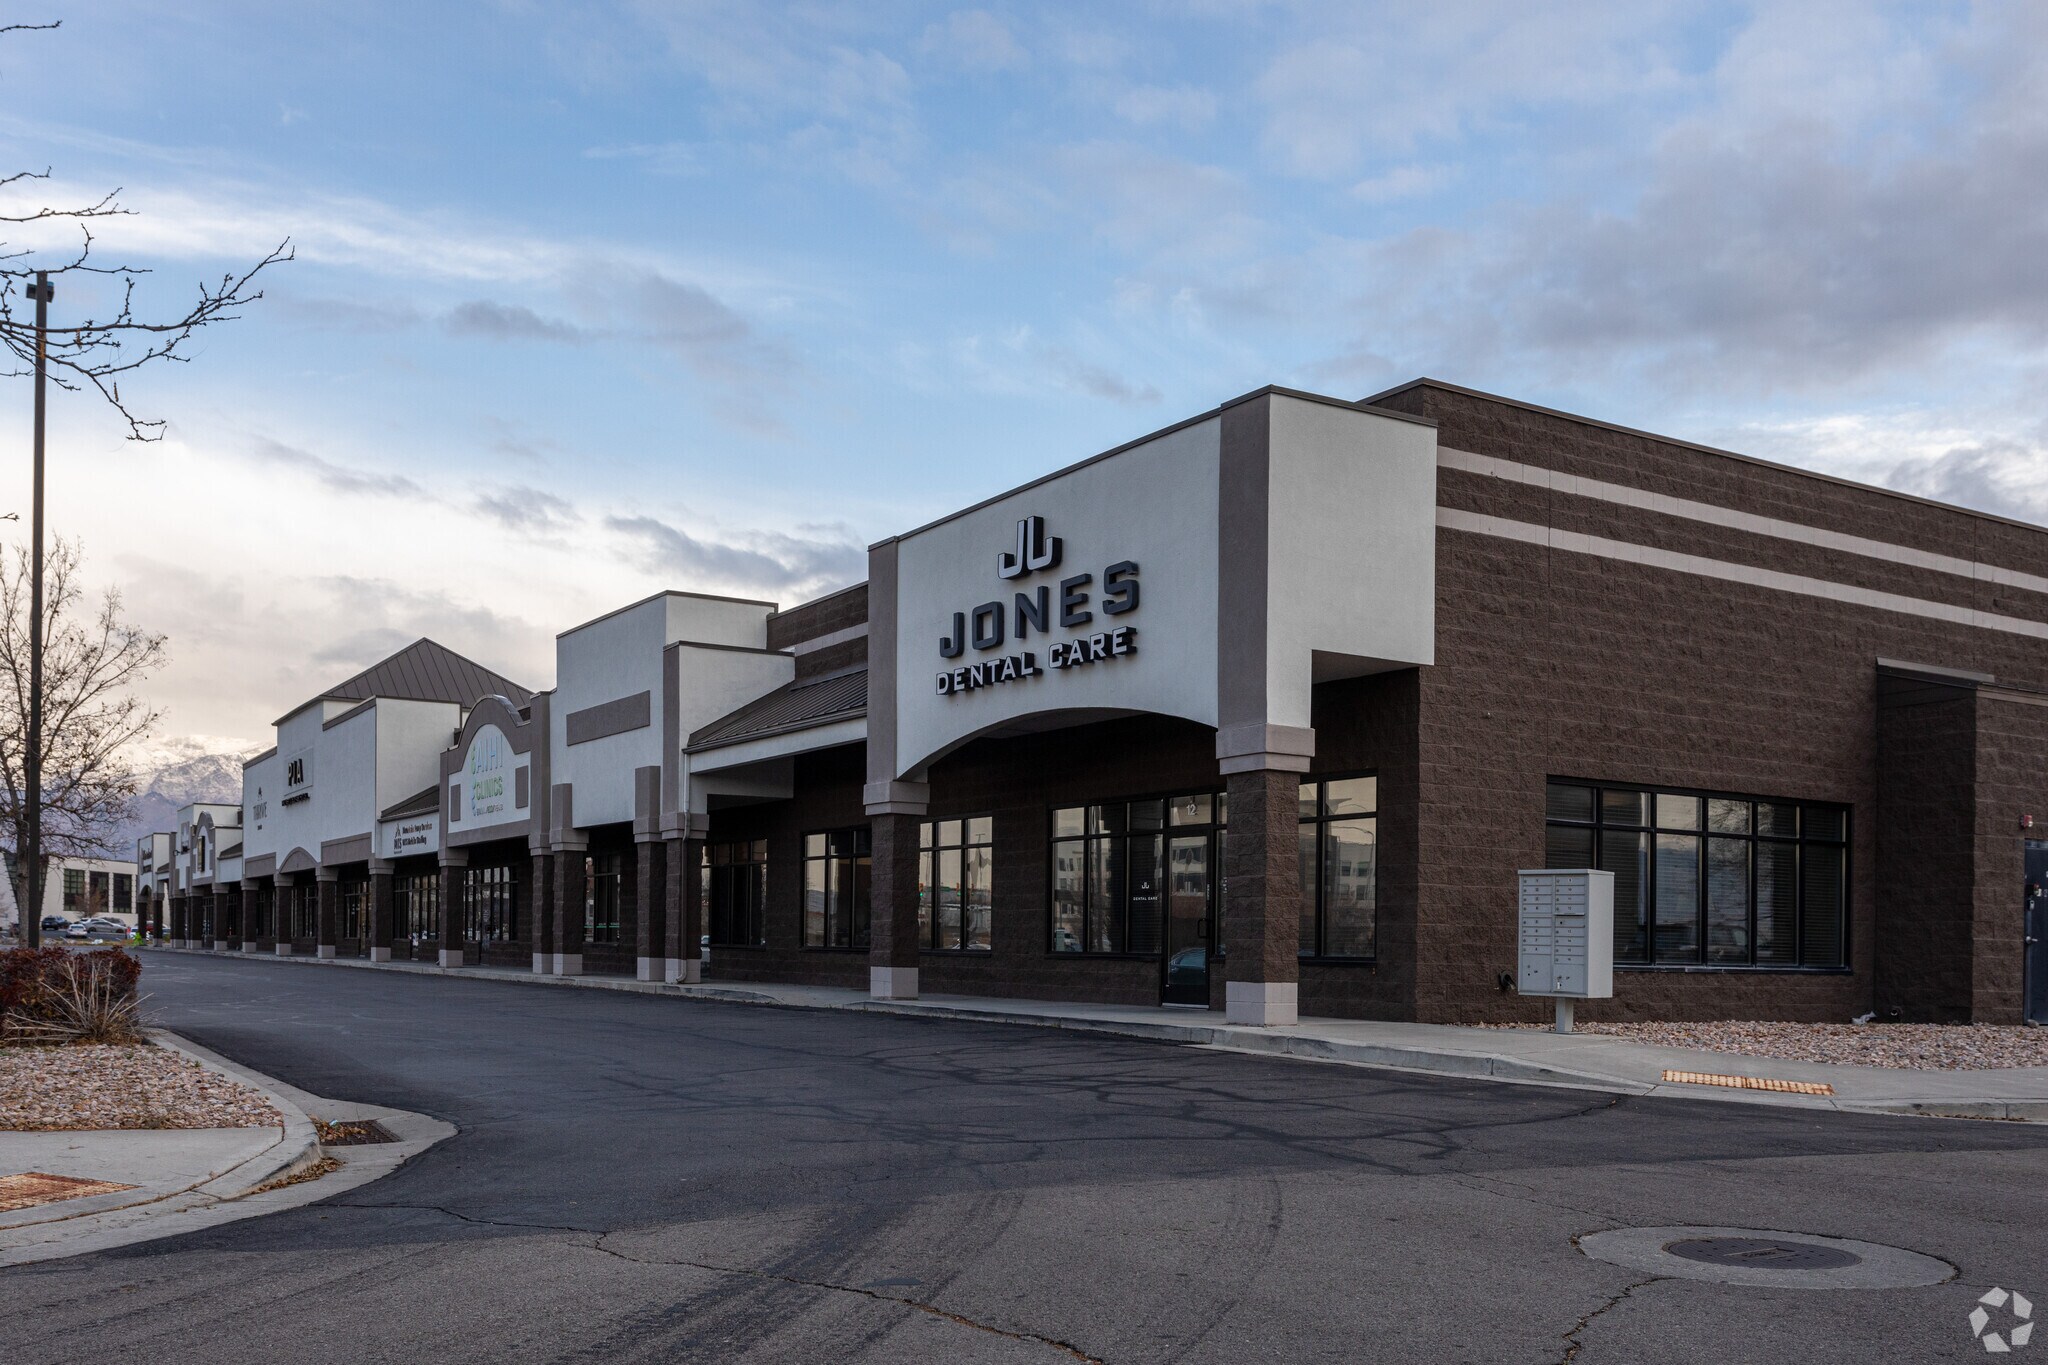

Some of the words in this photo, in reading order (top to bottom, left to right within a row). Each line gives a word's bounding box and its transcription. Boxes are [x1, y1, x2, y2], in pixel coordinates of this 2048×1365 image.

[939, 560, 1140, 658] JONES
[935, 652, 1043, 695] DENTAL
[1049, 626, 1138, 669] CARE
[476, 775, 503, 800] CLINICS
[1186, 803, 1197, 816] 12
